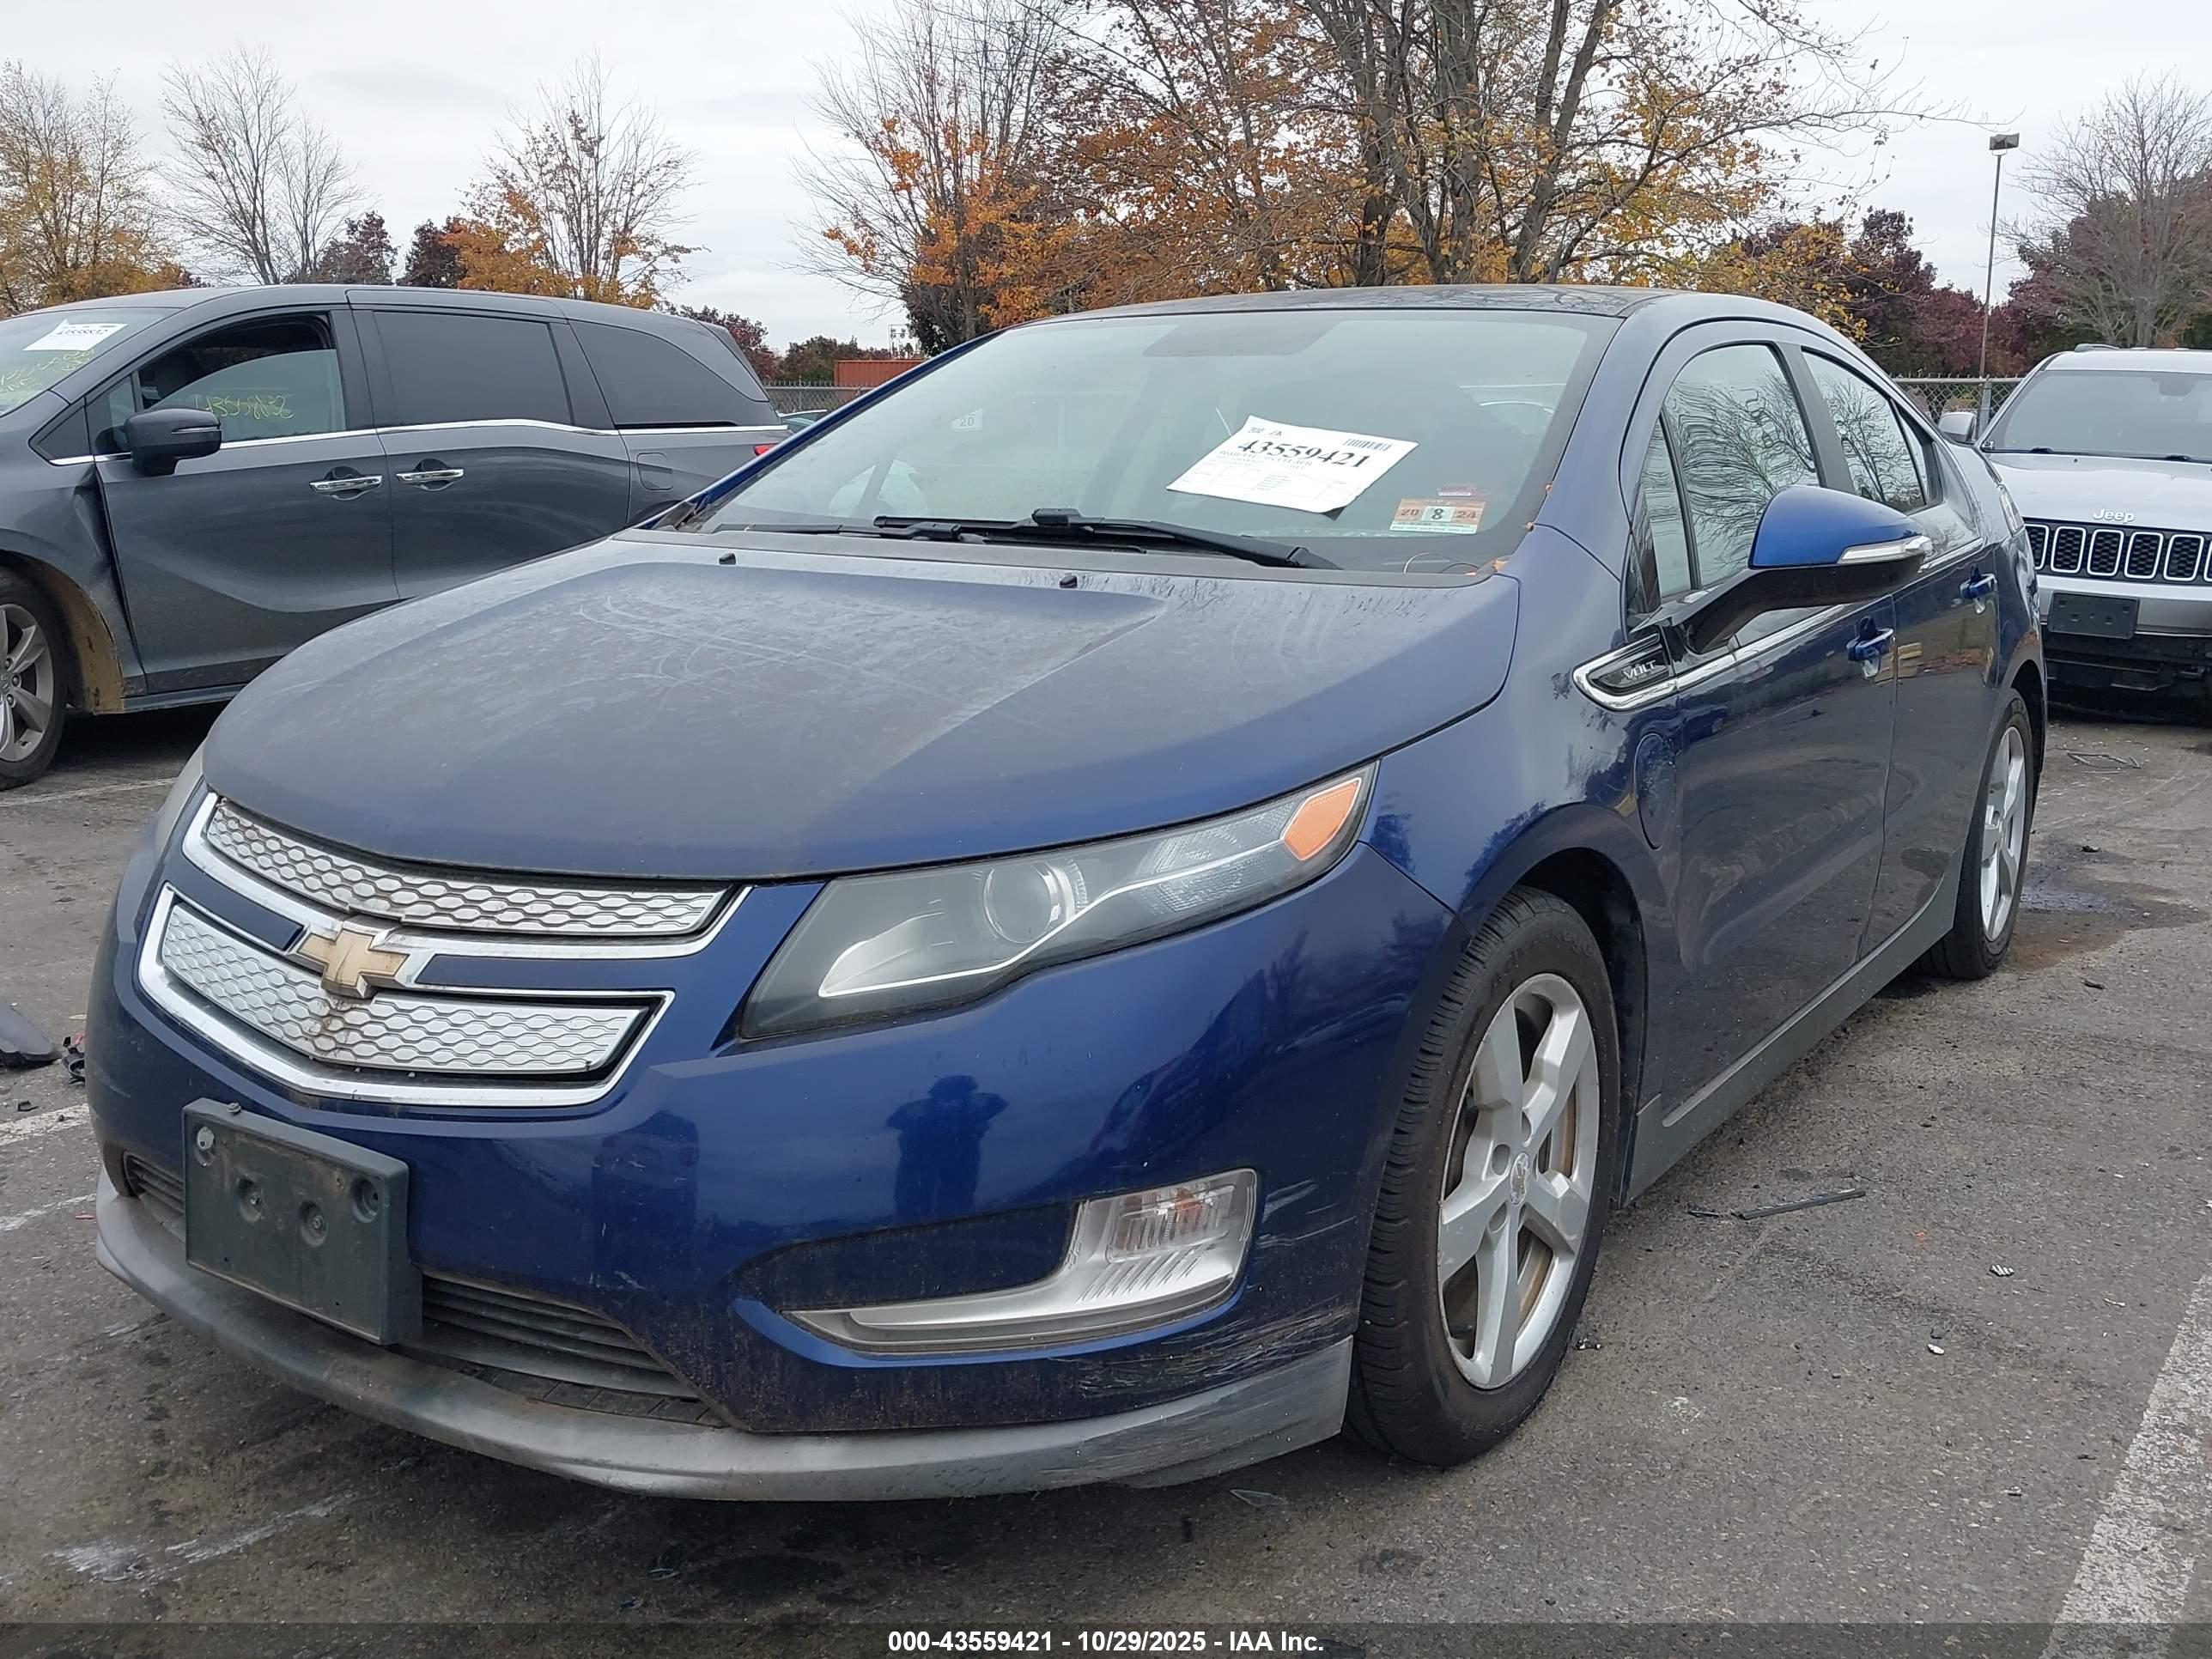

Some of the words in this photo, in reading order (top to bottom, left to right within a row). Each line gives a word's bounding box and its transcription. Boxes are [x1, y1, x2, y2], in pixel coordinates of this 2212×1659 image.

[1237, 439, 1370, 468] 43559421
[1431, 508, 1444, 520] 8
[2093, 508, 2136, 523] Jeep
[1621, 659, 1656, 679] VOLT
